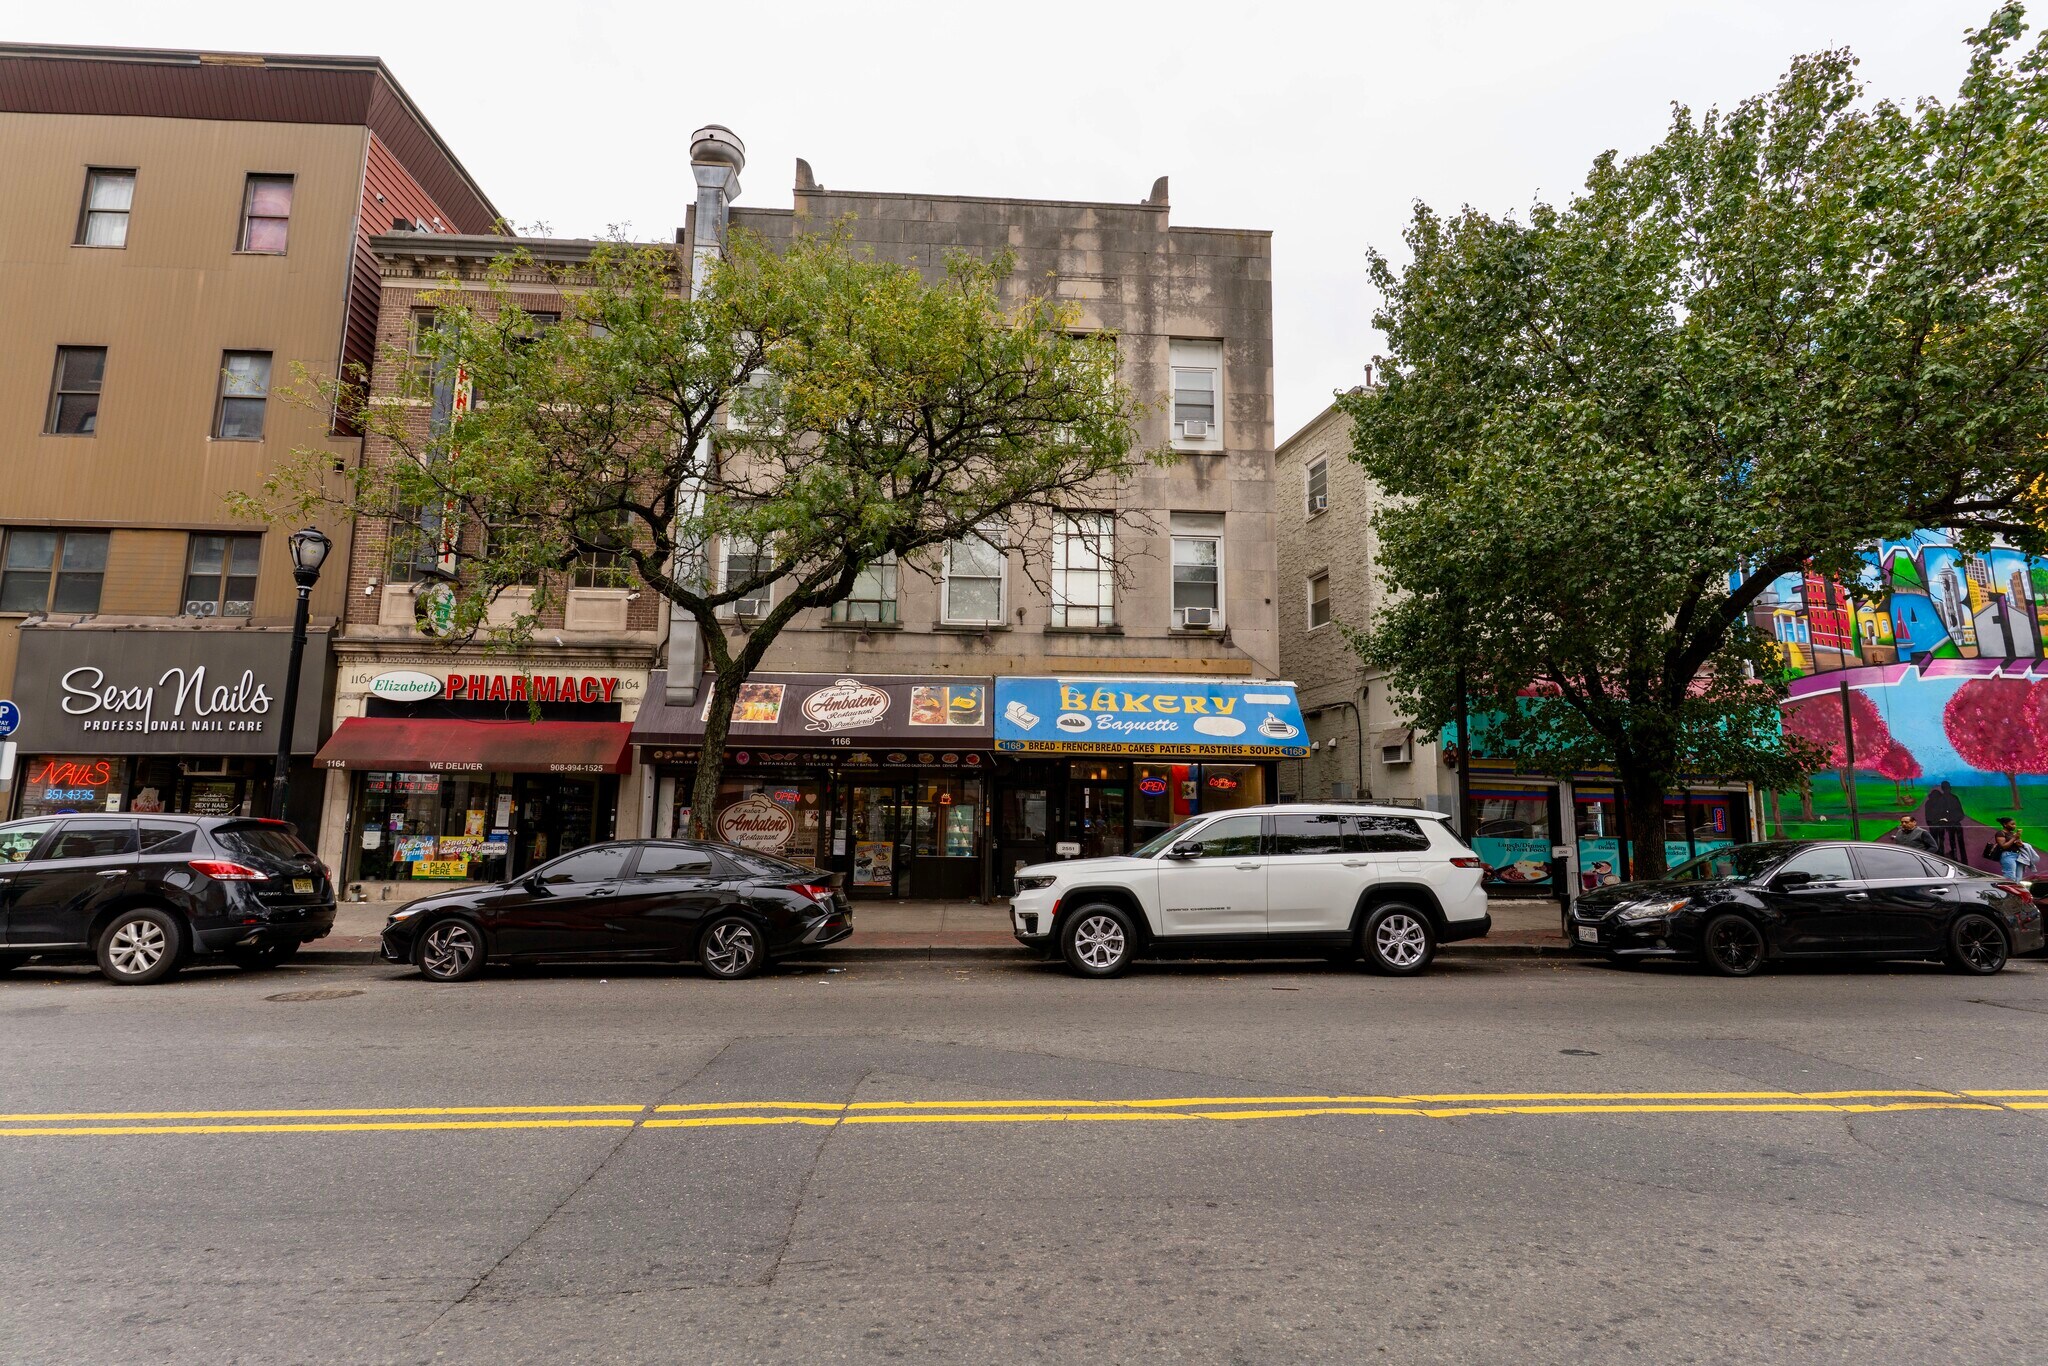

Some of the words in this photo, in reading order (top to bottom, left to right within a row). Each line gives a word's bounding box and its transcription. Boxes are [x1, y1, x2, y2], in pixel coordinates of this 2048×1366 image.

[374, 679, 438, 693] Elizabeth
[445, 673, 619, 703] PHARMACY
[61, 666, 154, 734] Sexy
[158, 665, 274, 716] Nails
[811, 693, 882, 713] Ambateño
[1060, 684, 1237, 715] BAKERY
[827, 707, 875, 719] Restaurant
[83, 720, 186, 734] PROFESSIONAL
[191, 720, 223, 732] NAIL
[228, 720, 263, 732] CARE
[1095, 714, 1179, 735] Baguette
[1001, 742, 1021, 750] 1168
[1028, 742, 1055, 751] BREAD
[1062, 743, 1094, 751] FRENCH
[1096, 743, 1122, 752] BREAD
[1128, 744, 1155, 753] CAKES
[1159, 745, 1191, 754] PATIES
[1199, 745, 1242, 755] PASTRIES
[1250, 746, 1280, 755] SOUPS
[1284, 747, 1303, 755] 1168
[326, 760, 345, 768] 1164
[446, 762, 482, 770] DELIVER
[550, 764, 603, 772] 908-994-1525
[32, 761, 111, 786] NAILS
[1140, 781, 1166, 791] OPEN
[45, 789, 95, 800] 351-4335
[775, 791, 800, 802] OPEN
[725, 813, 788, 832] Ambateño
[414, 840, 434, 848] Cold
[401, 848, 433, 857] Drinks!
